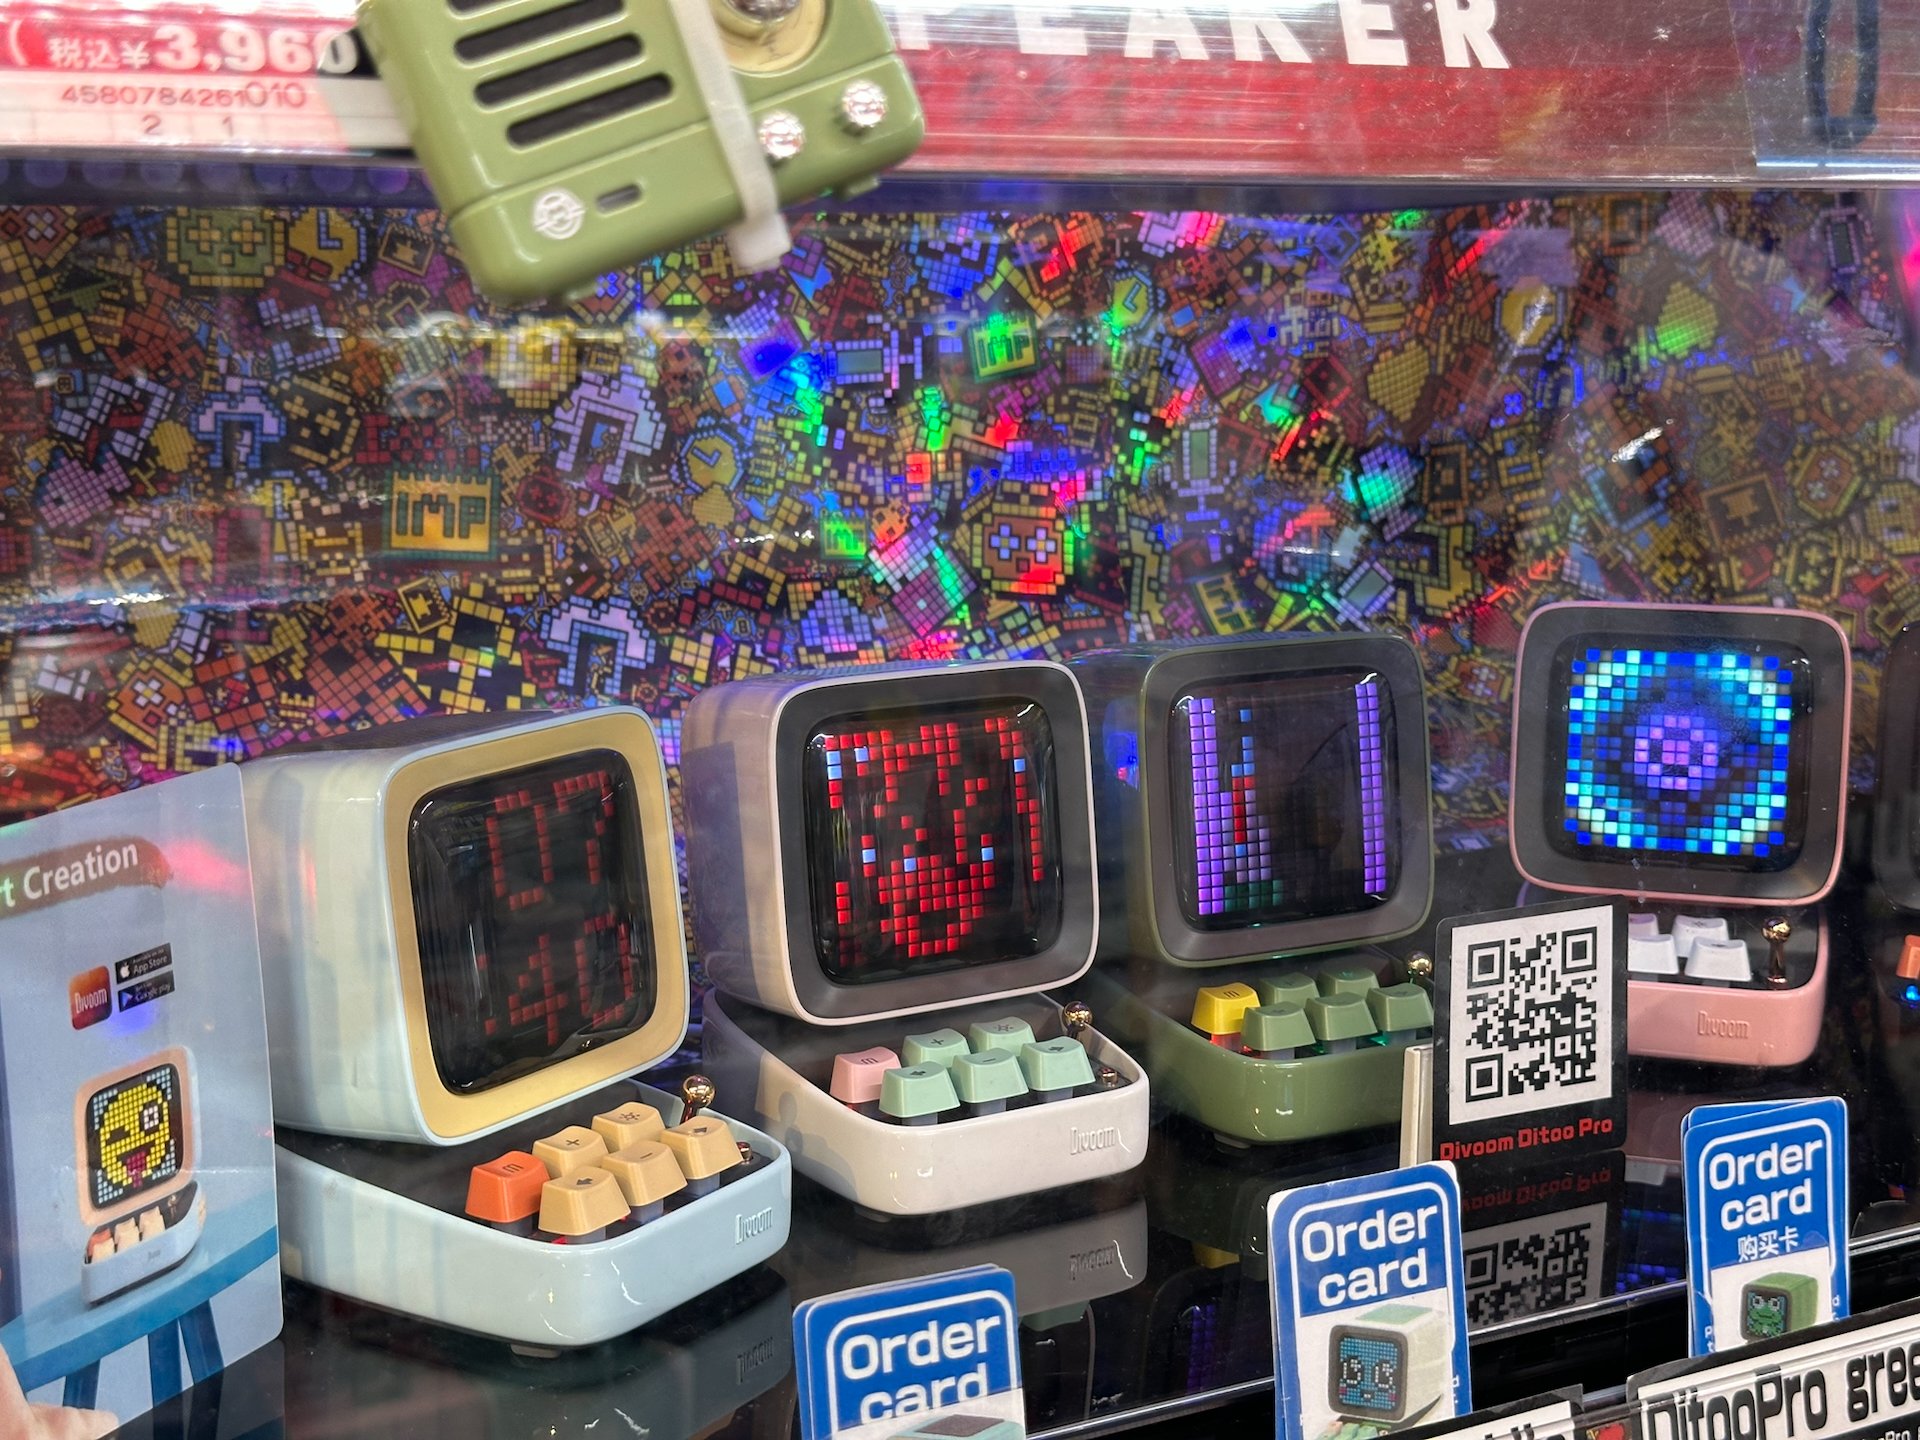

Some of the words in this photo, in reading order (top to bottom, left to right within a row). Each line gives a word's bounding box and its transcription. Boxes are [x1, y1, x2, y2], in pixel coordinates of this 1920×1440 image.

[61, 82, 307, 109] 4580784261010
[141, 114, 162, 136] 2
[396, 492, 486, 539] IMP
[23, 843, 138, 900] Creation
[1697, 1010, 1749, 1039] Divoom
[1070, 1126, 1116, 1155] Divoom
[1440, 1136, 1514, 1161] Divoom
[1518, 1126, 1575, 1147] Ditoo
[1579, 1117, 1613, 1137] Pro
[1709, 1138, 1823, 1191] Order
[735, 1206, 773, 1245] Divoom
[1720, 1178, 1813, 1232] card
[1301, 1205, 1438, 1263] Order
[1738, 1226, 1799, 1263] 购买卡
[1317, 1247, 1428, 1308] card
[841, 1314, 1001, 1380] Order
[859, 1361, 989, 1426] card
